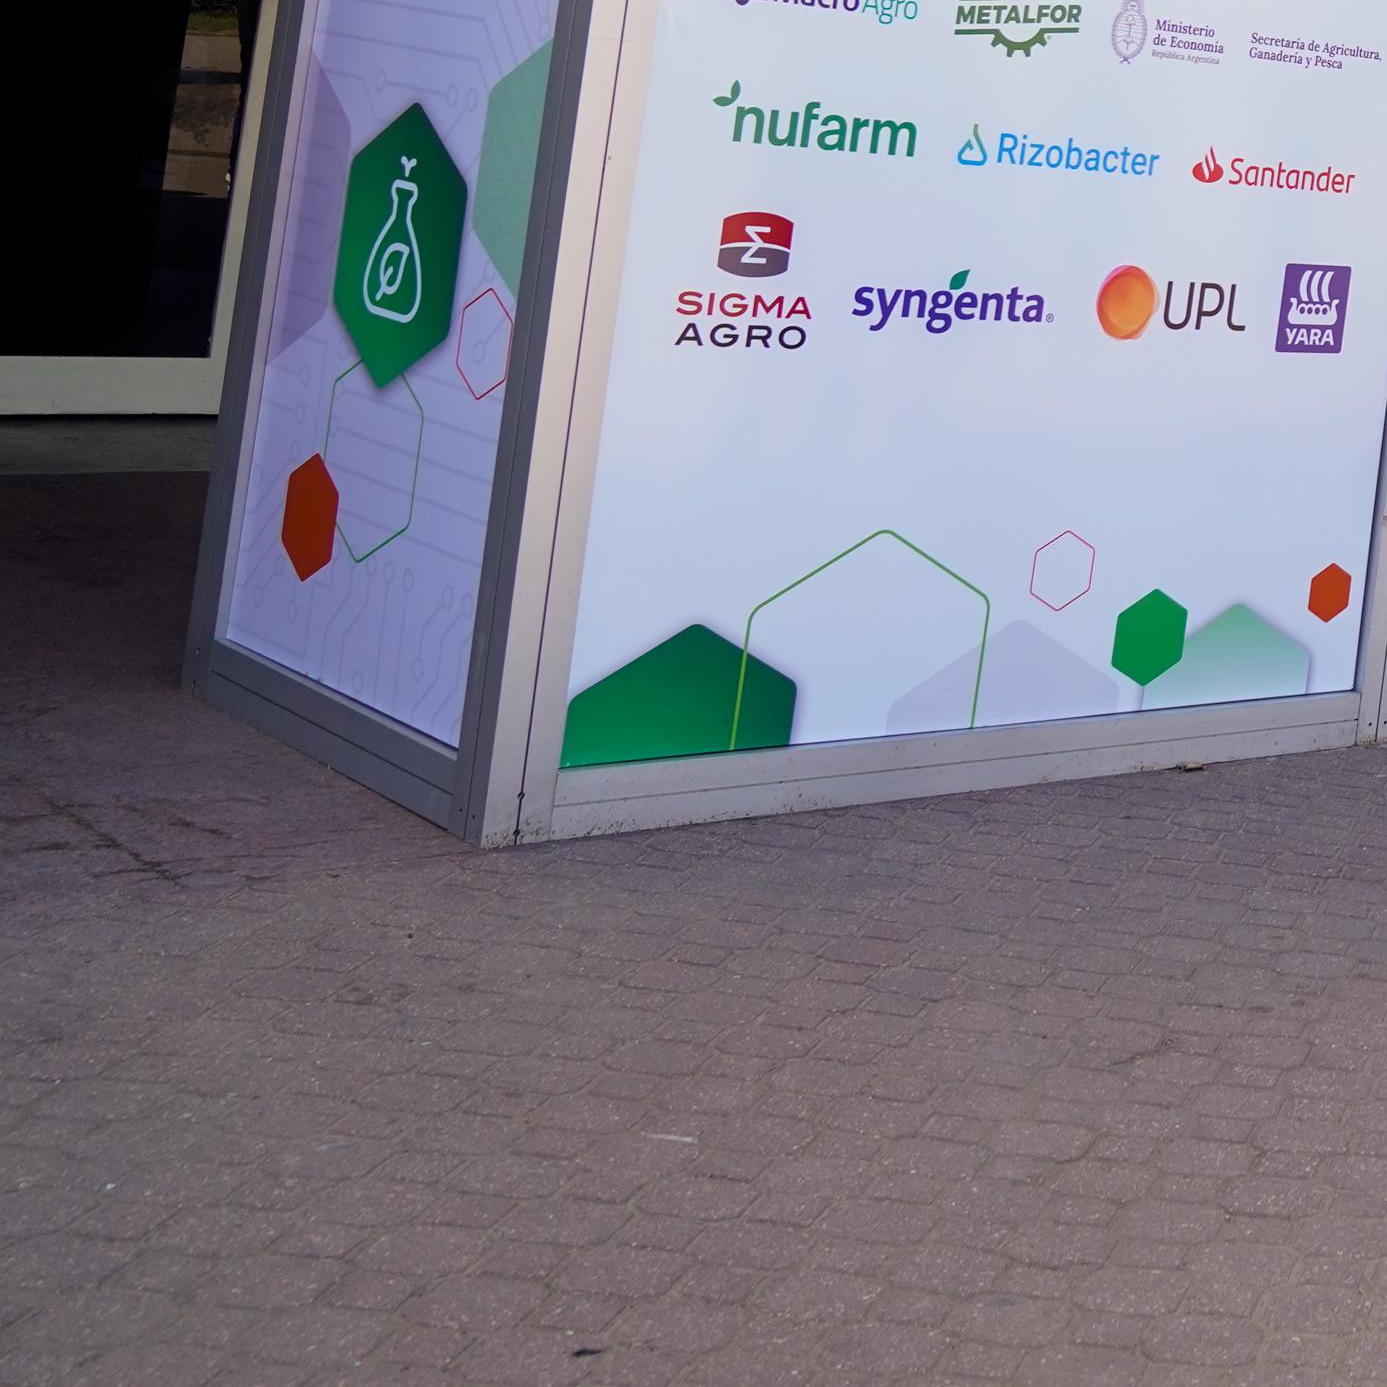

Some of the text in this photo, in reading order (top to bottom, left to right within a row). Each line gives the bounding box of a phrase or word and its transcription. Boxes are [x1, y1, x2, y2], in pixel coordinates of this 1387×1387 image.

[955, 4, 1083, 25] METALFOR
[1155, 18, 1215, 38] Ministerio
[1151, 48, 1221, 66] República Argentina
[1153, 33, 1225, 55] de Economía
[1249, 46, 1344, 70] Ganadería y Pesca
[1251, 32, 1383, 63] Secretaría de Agricultura,
[732, 101, 917, 157] nufarm
[996, 132, 1160, 176] Rizobacter
[1228, 156, 1356, 194] Santander
[675, 290, 812, 320] SIGMA
[851, 285, 1045, 334] syngenta
[1163, 281, 1246, 331] UPL
[674, 322, 807, 350] AGRO
[1285, 328, 1335, 346] YARA
